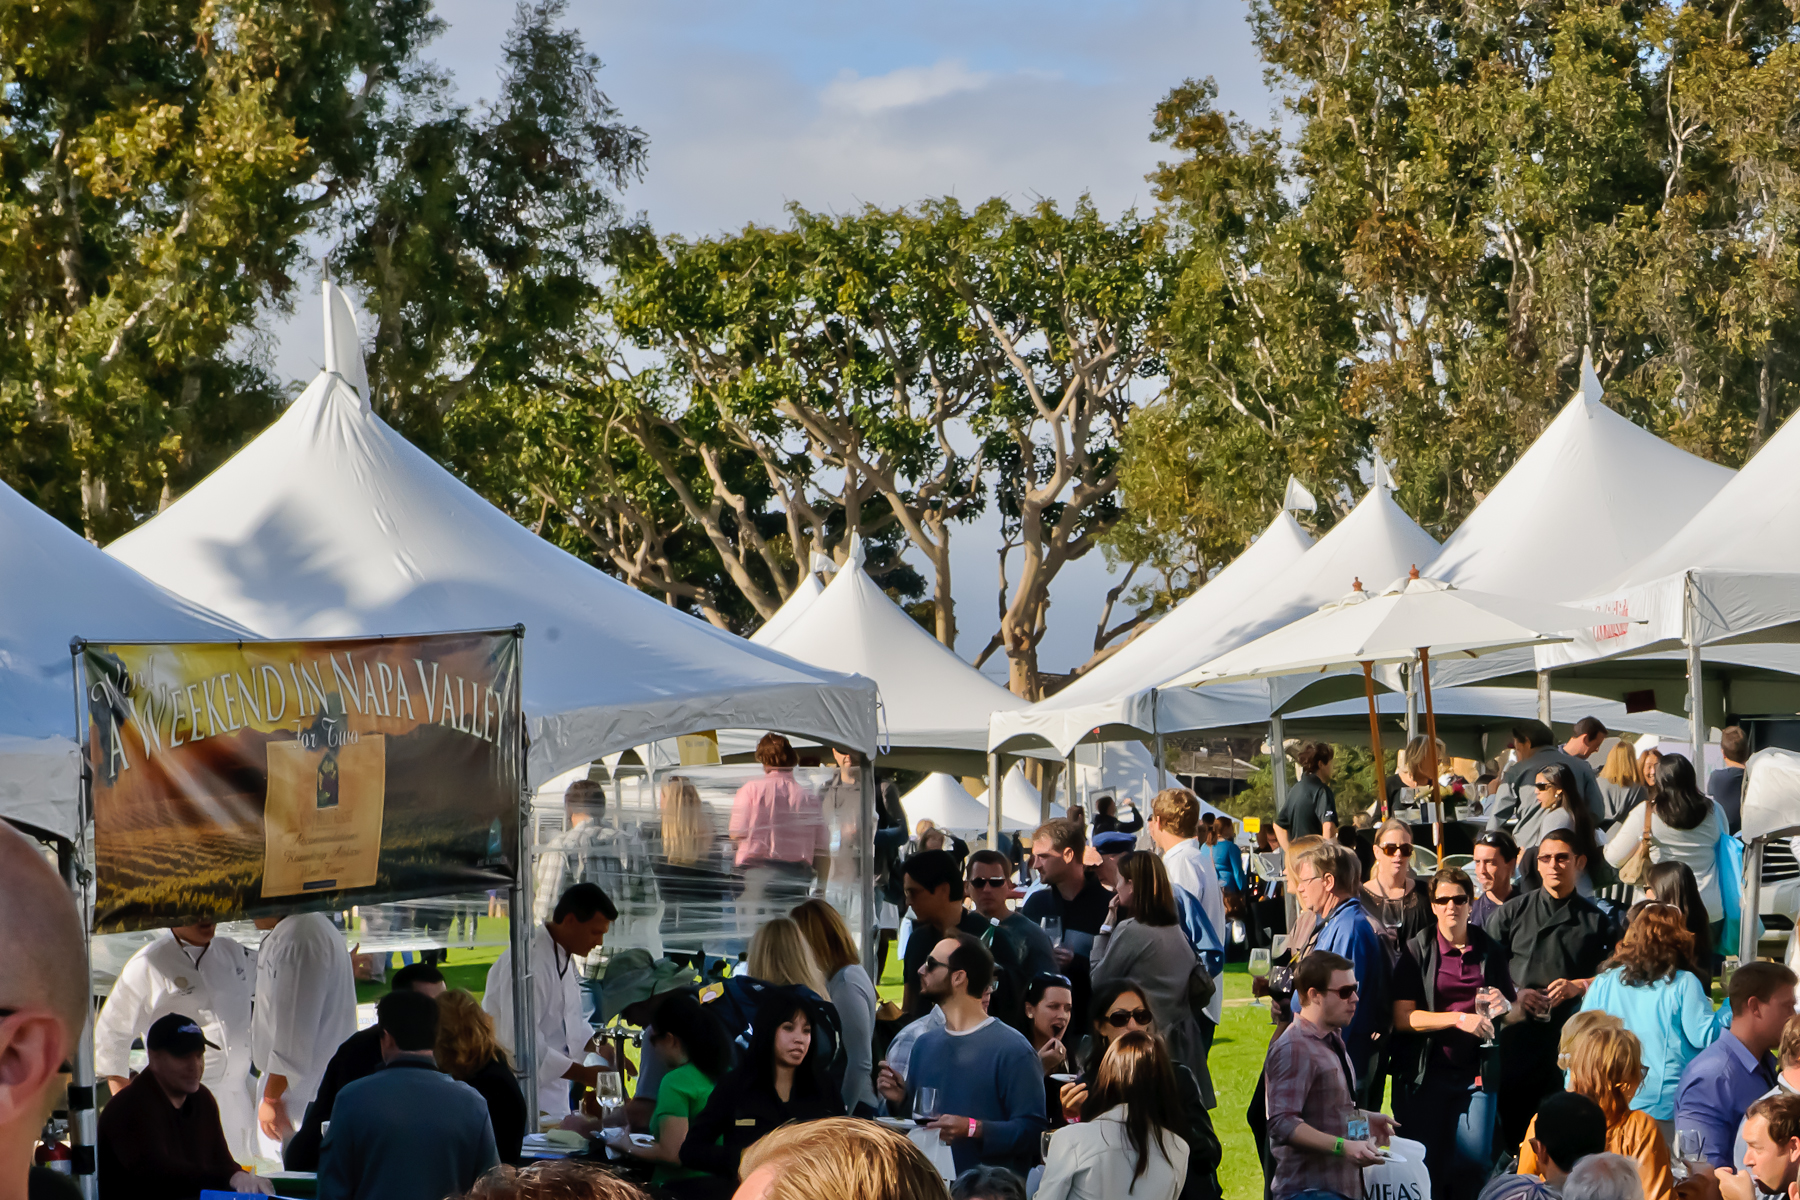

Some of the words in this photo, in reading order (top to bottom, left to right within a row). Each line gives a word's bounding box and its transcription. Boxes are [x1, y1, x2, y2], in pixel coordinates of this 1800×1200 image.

[91, 654, 154, 708] Win!
[109, 714, 129, 778] A
[128, 665, 285, 760] WEEKEND
[289, 661, 328, 716] IN
[330, 651, 414, 721] NAPA
[413, 659, 504, 748] VALLEY
